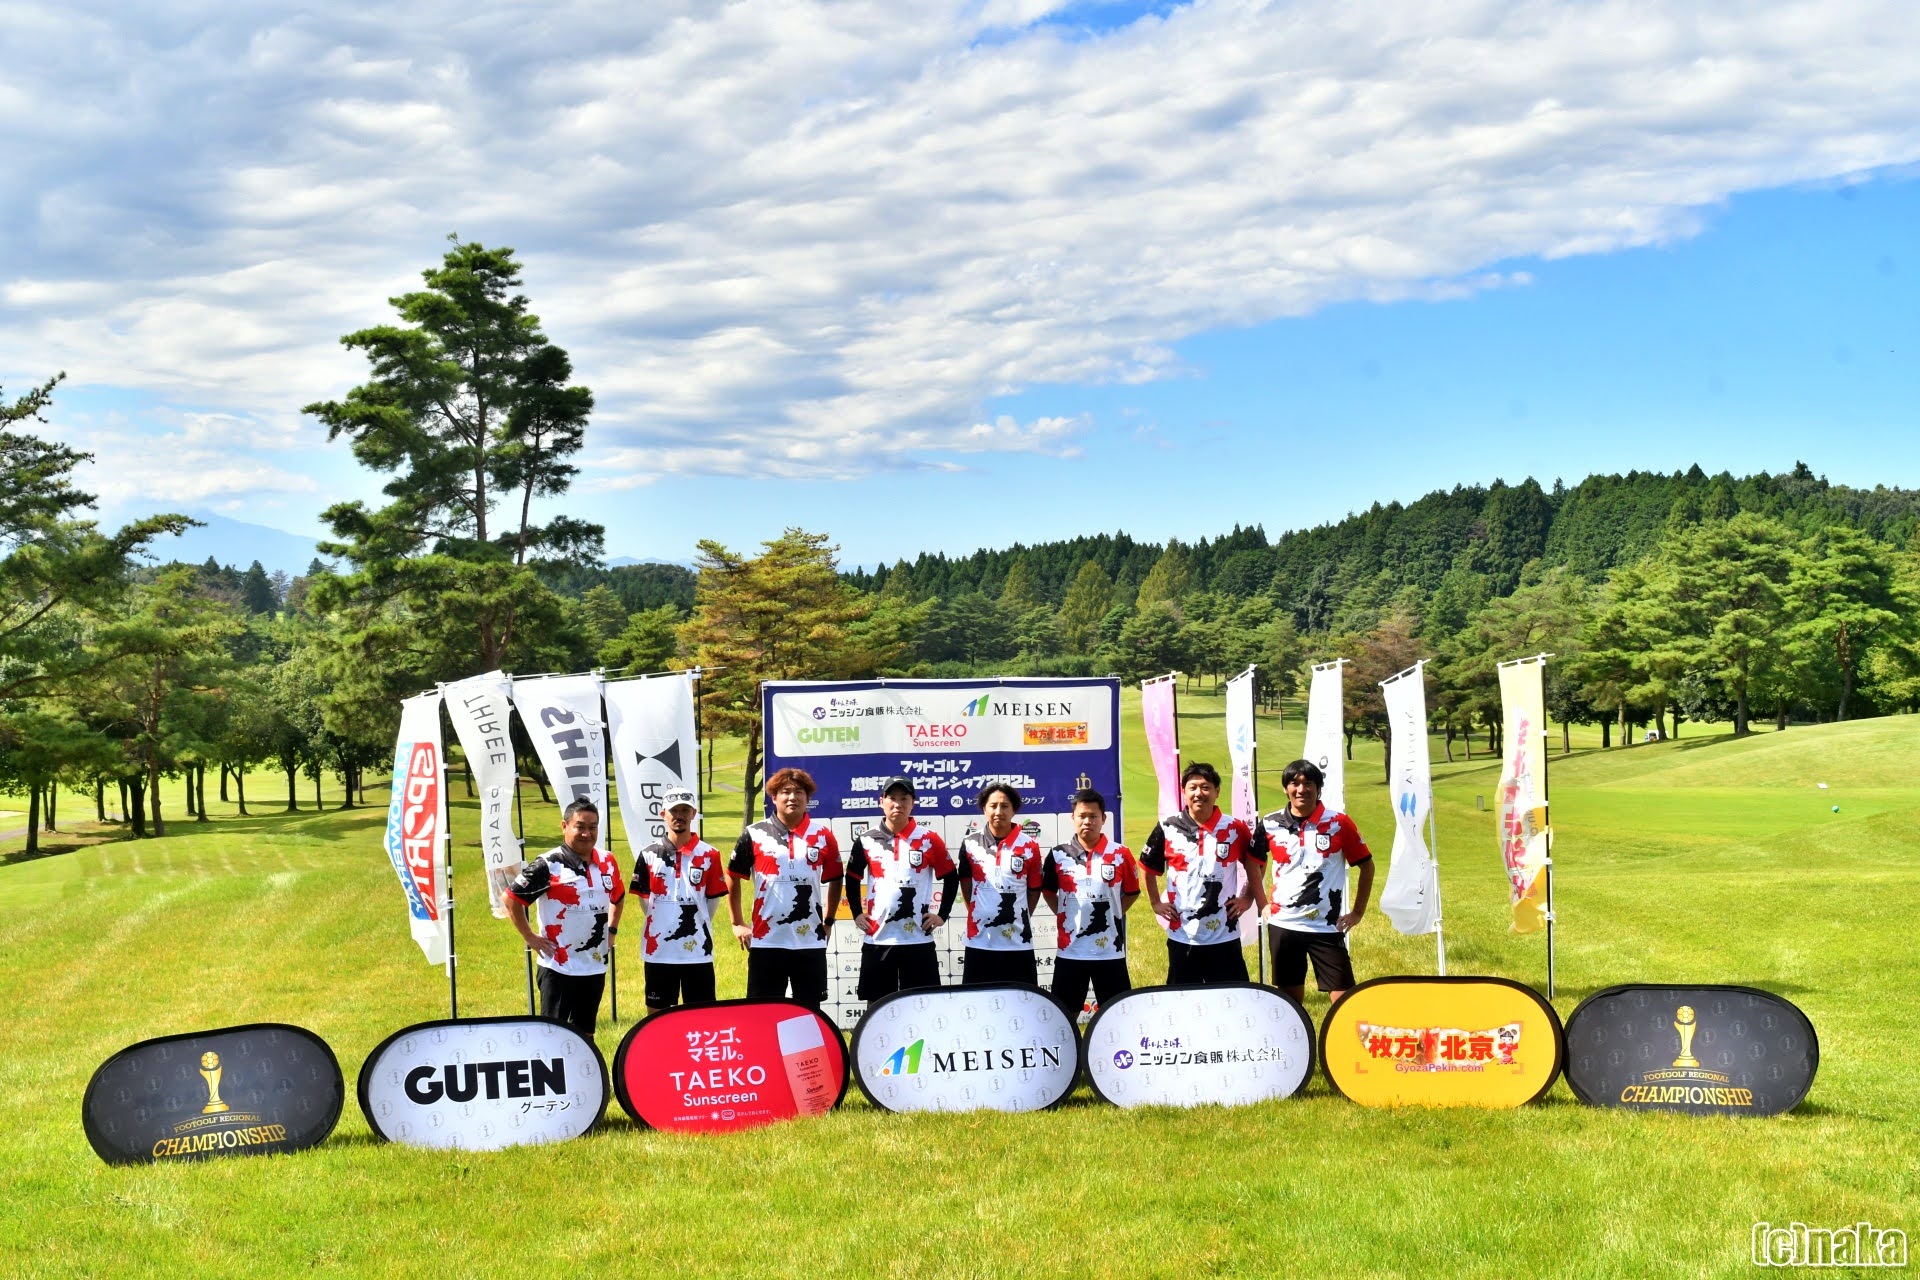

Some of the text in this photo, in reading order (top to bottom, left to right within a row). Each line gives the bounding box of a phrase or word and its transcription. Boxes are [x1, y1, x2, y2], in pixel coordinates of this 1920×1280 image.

[993, 702, 1072, 717] MEISEN
[797, 726, 860, 743] GUTEN
[906, 724, 967, 738] TAEKO
[913, 738, 960, 747] Sunscreen
[901, 759, 972, 774] フットゴルフ
[685, 1027, 741, 1046] サンゴ、
[687, 1046, 744, 1062] マモル。
[933, 1046, 1060, 1073] MEISEN
[1139, 1047, 1285, 1067] ニッシン食販株式会社
[795, 1057, 819, 1068] TAEKO
[1395, 1063, 1484, 1074] GyozaPekin.com
[404, 1058, 567, 1105] GUTEN
[670, 1065, 766, 1091] TAEKO
[1643, 1071, 1730, 1083] FOOTGOLF REGIONAL
[683, 1091, 758, 1107] Sunscreen
[1620, 1085, 1753, 1106] CHAMPIONSHIP
[521, 1100, 571, 1114] グーテン
[173, 1114, 261, 1133] FOOTGOLF REGIONAL
[152, 1124, 286, 1157] CHAMPIONSHIP
